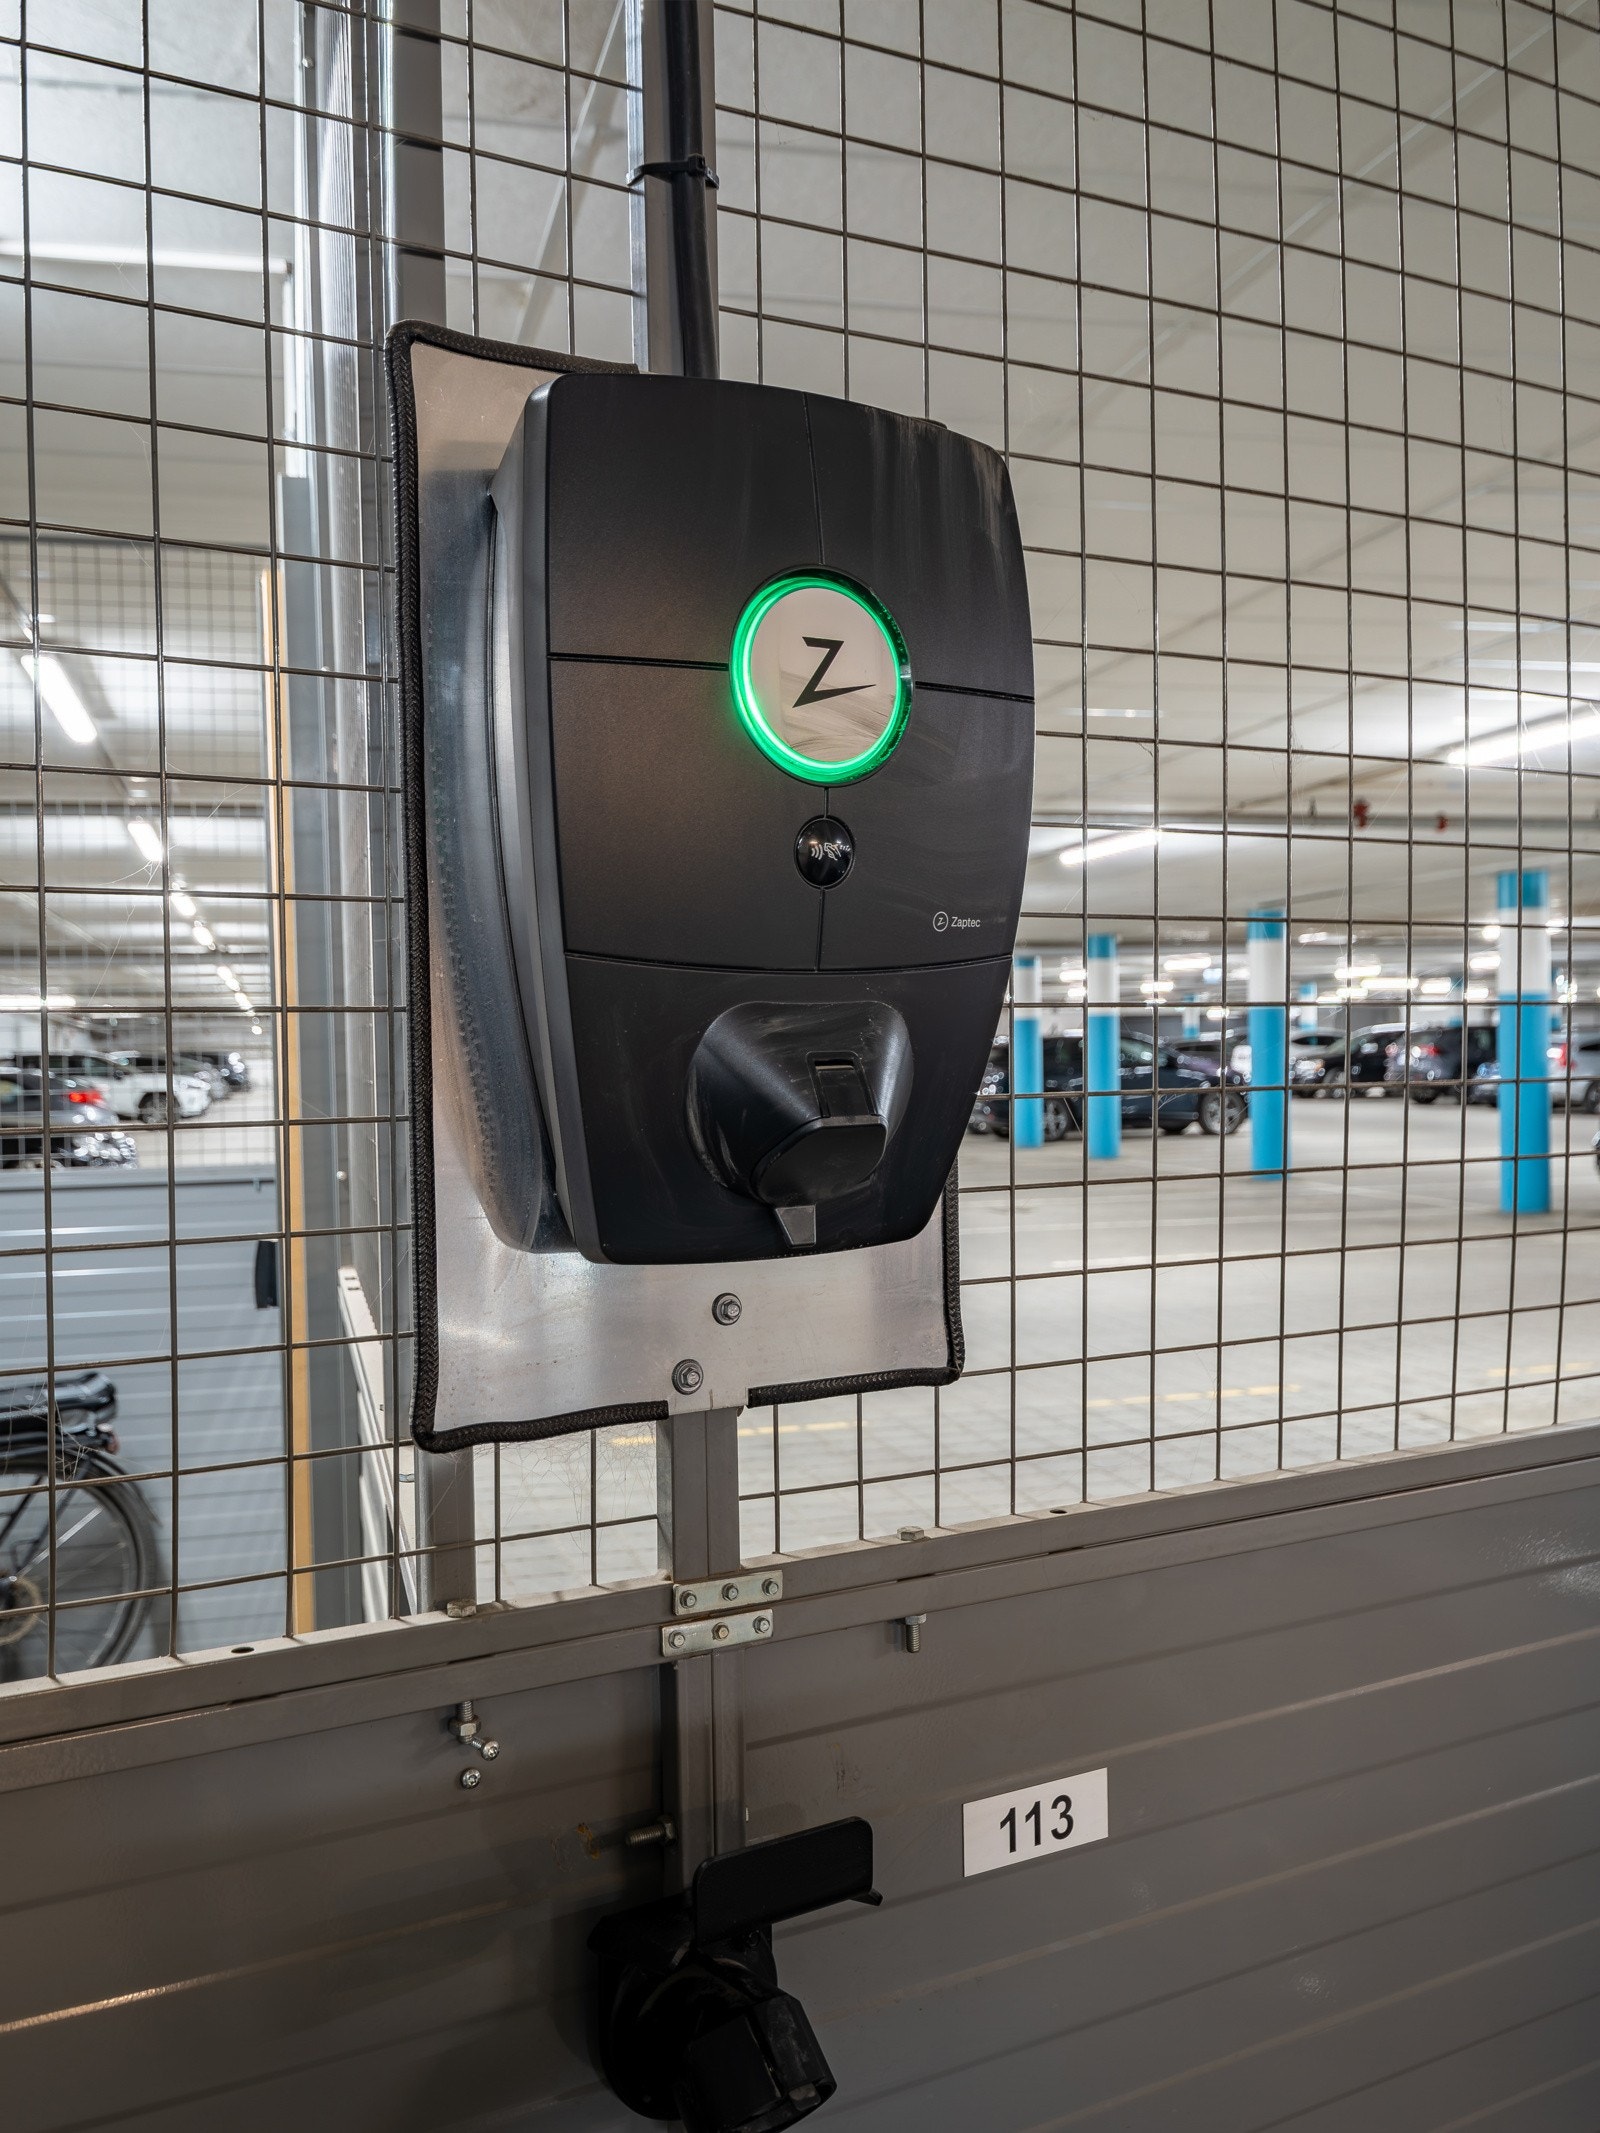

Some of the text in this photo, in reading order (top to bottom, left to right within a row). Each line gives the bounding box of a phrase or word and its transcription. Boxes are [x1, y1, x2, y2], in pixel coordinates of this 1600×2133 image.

[792, 636, 876, 708] Z
[951, 916, 981, 930] Zaptec
[999, 1794, 1074, 1853] 113
